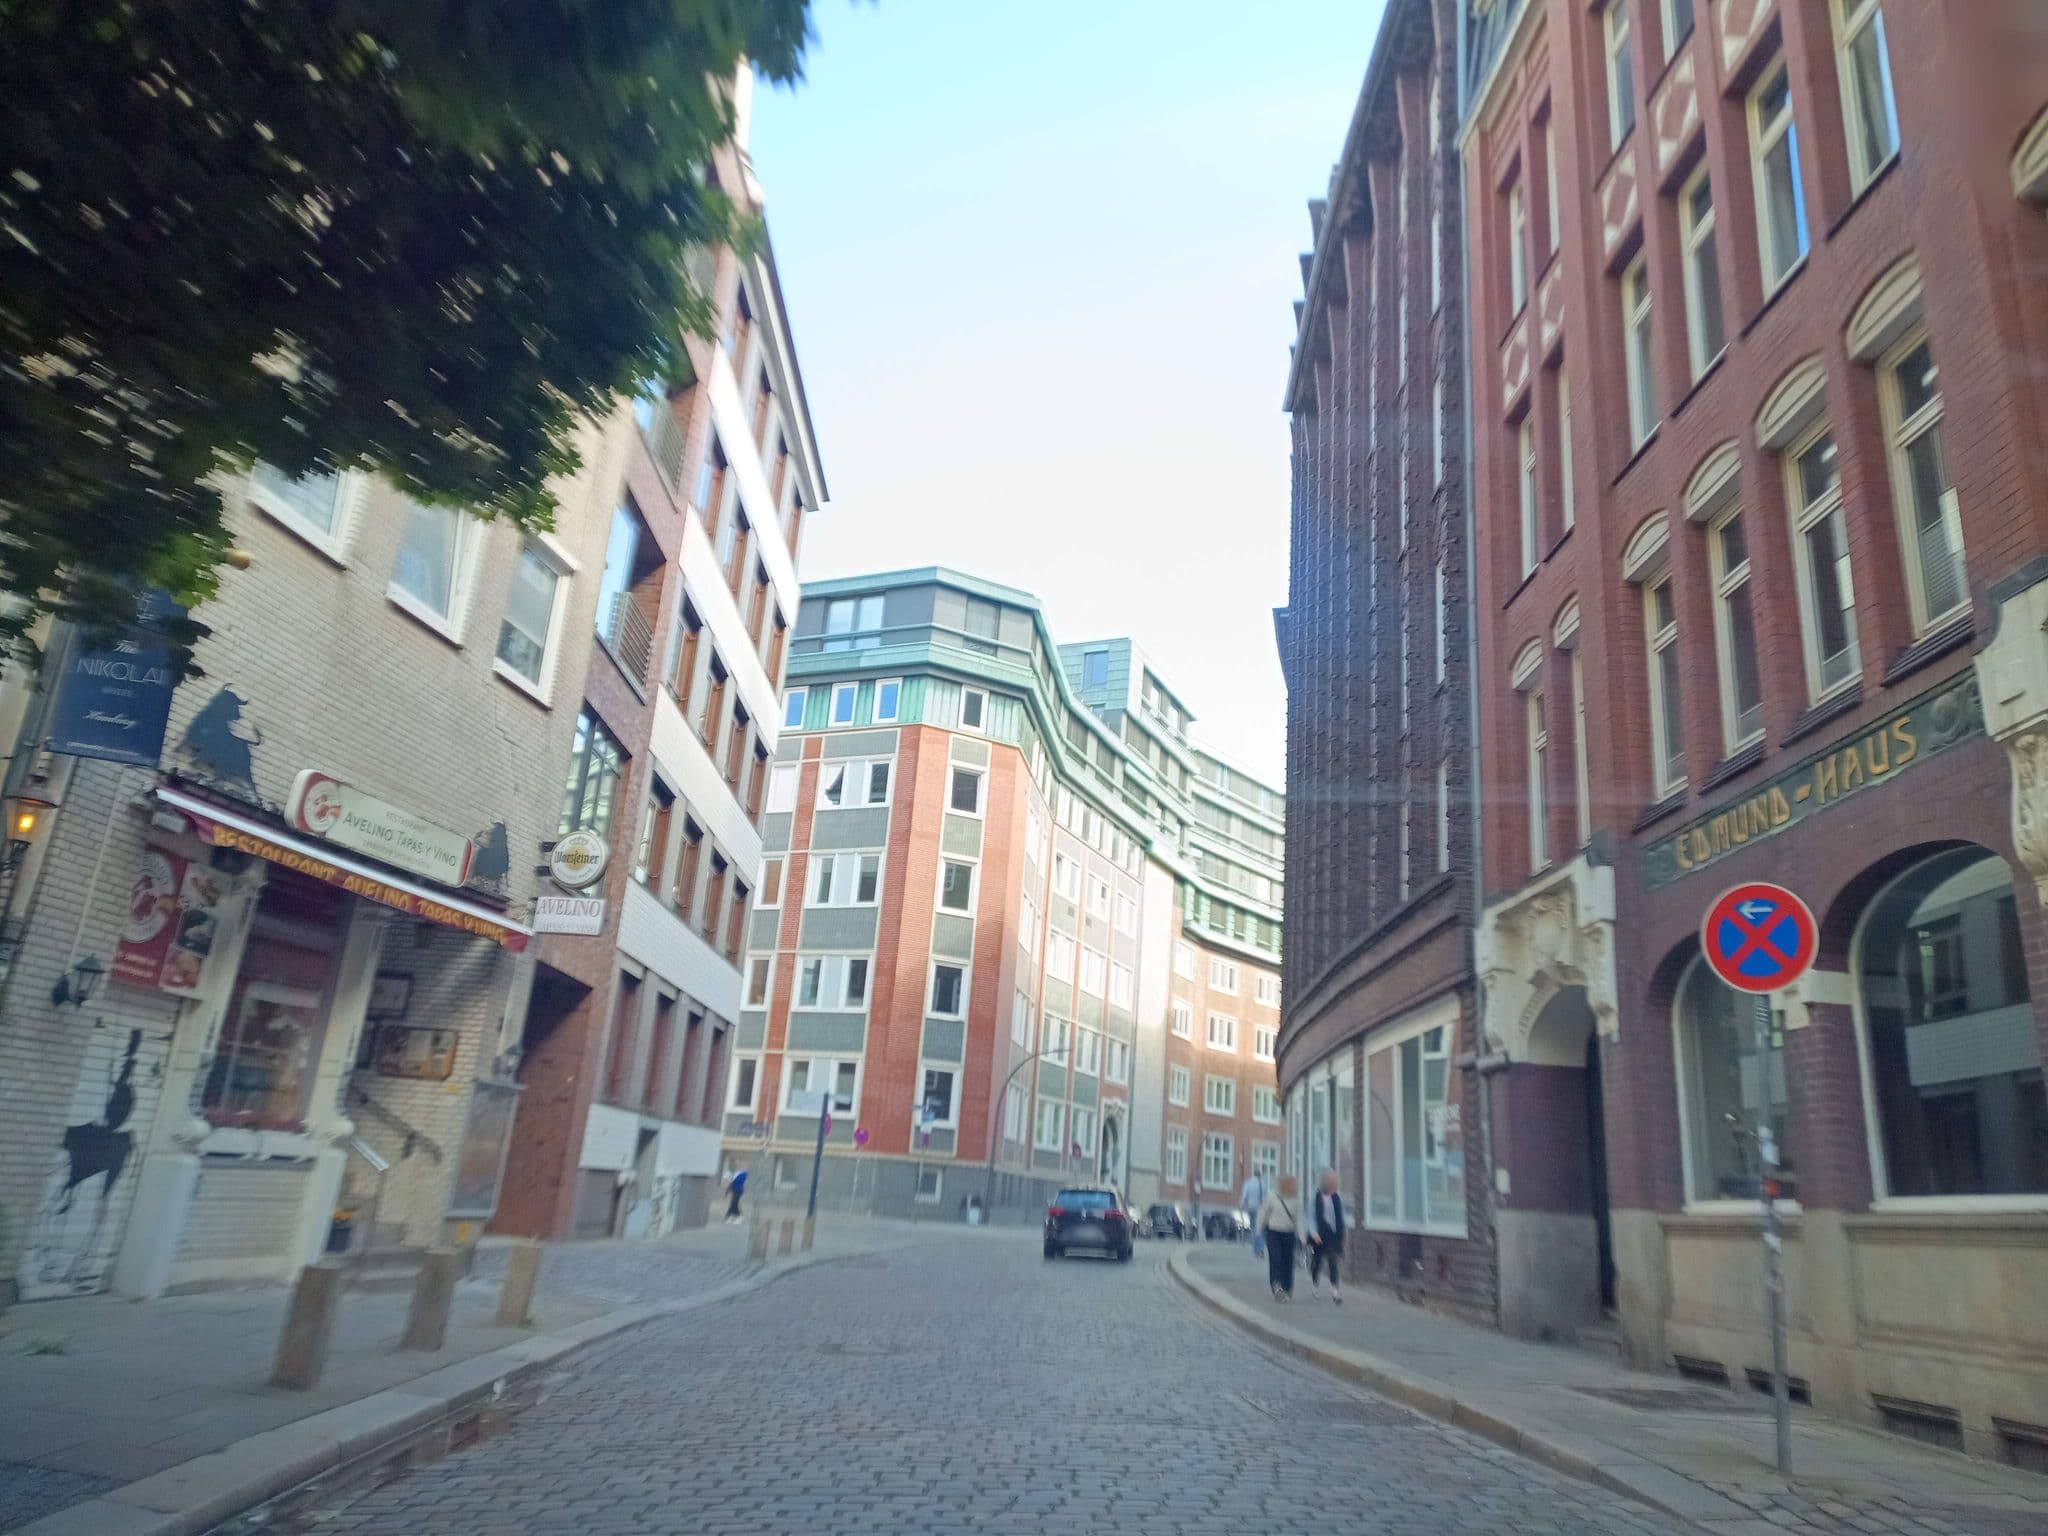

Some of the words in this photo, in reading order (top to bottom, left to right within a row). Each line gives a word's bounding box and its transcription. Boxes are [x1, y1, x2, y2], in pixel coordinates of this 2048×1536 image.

[76, 658, 167, 685] NIKOLAI
[342, 811, 393, 841] AVELINO
[397, 831, 423, 853] TAPAS
[425, 846, 432, 857] Y
[433, 846, 457, 867] VINO
[554, 850, 600, 865] Warsteiner
[536, 898, 600, 918] AVELINO
